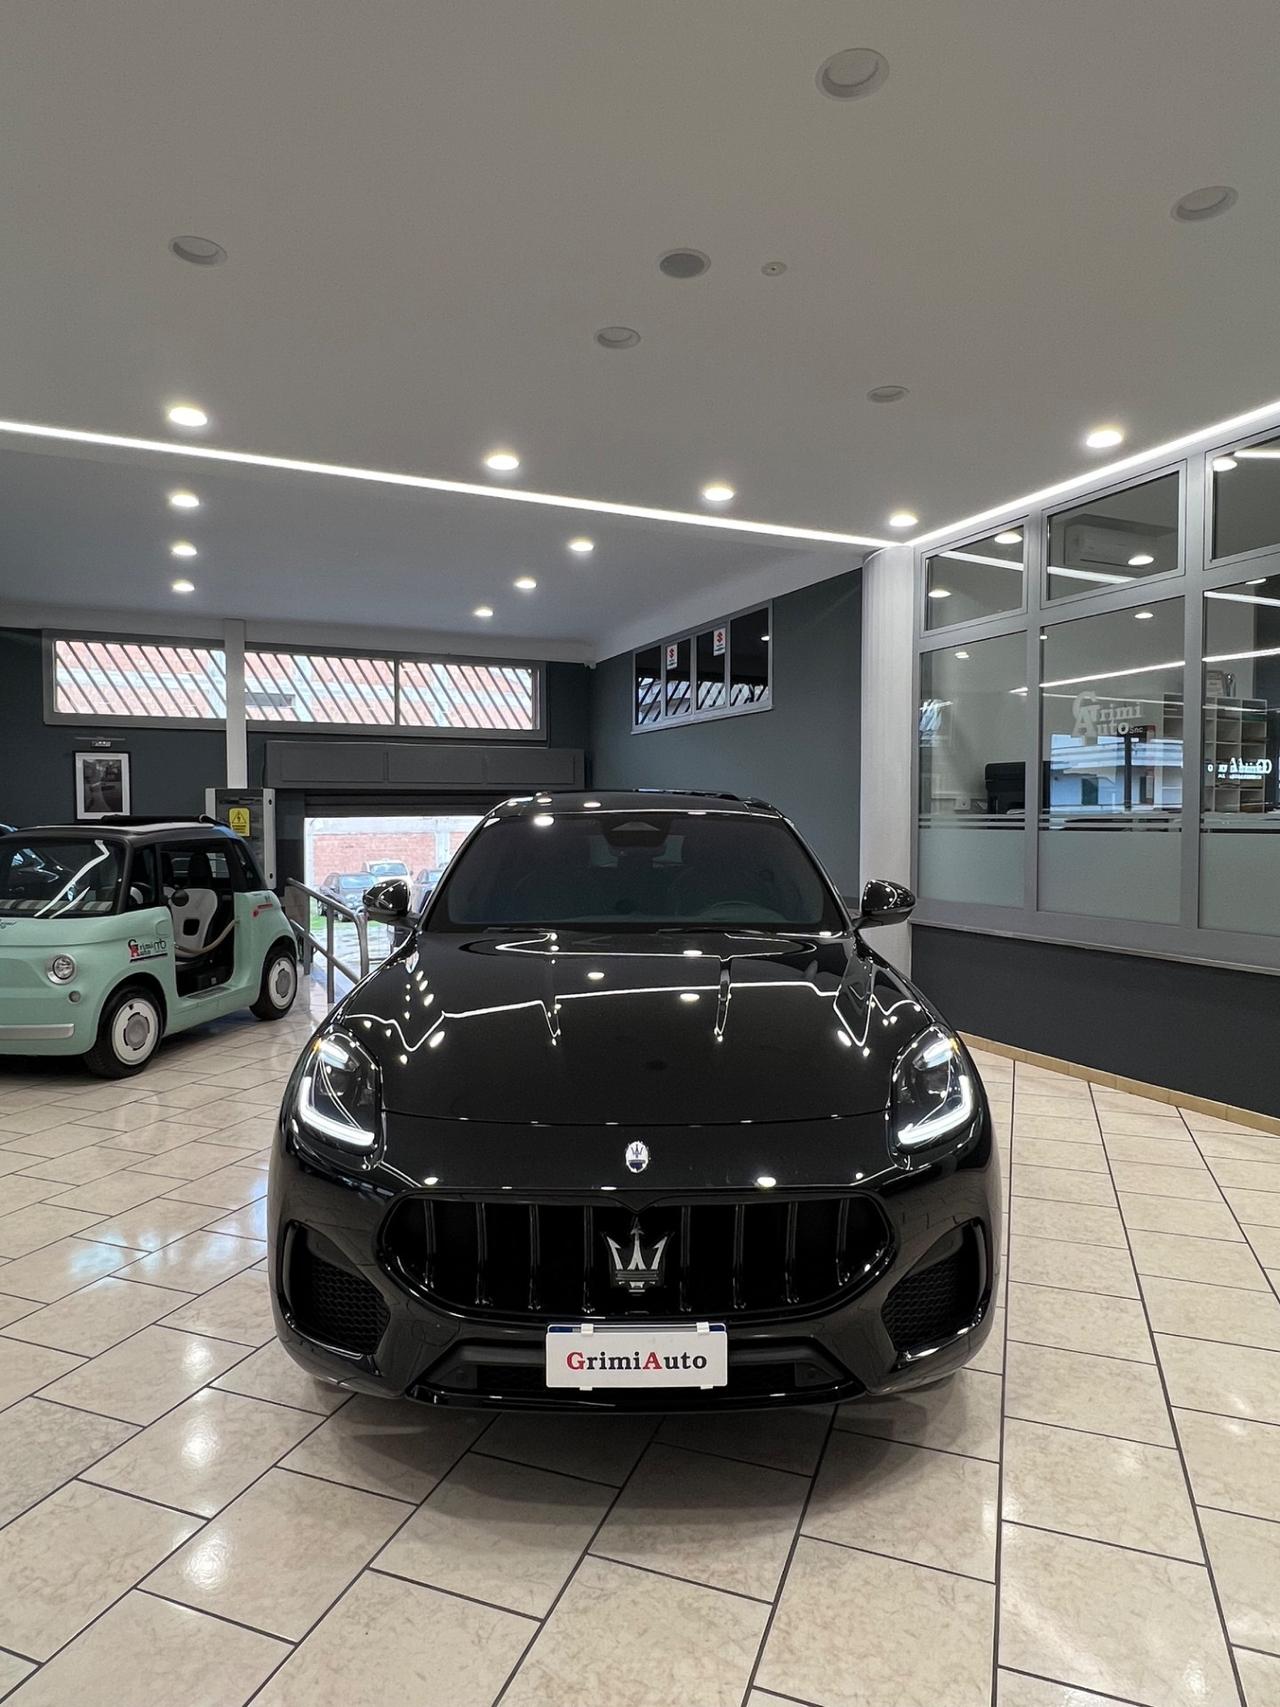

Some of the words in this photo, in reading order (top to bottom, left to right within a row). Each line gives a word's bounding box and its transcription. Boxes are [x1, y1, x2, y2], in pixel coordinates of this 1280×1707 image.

[1072, 691, 1142, 722] Grimi
[1072, 707, 1129, 737] Auto
[566, 1351, 707, 1370] GrimiAuto
